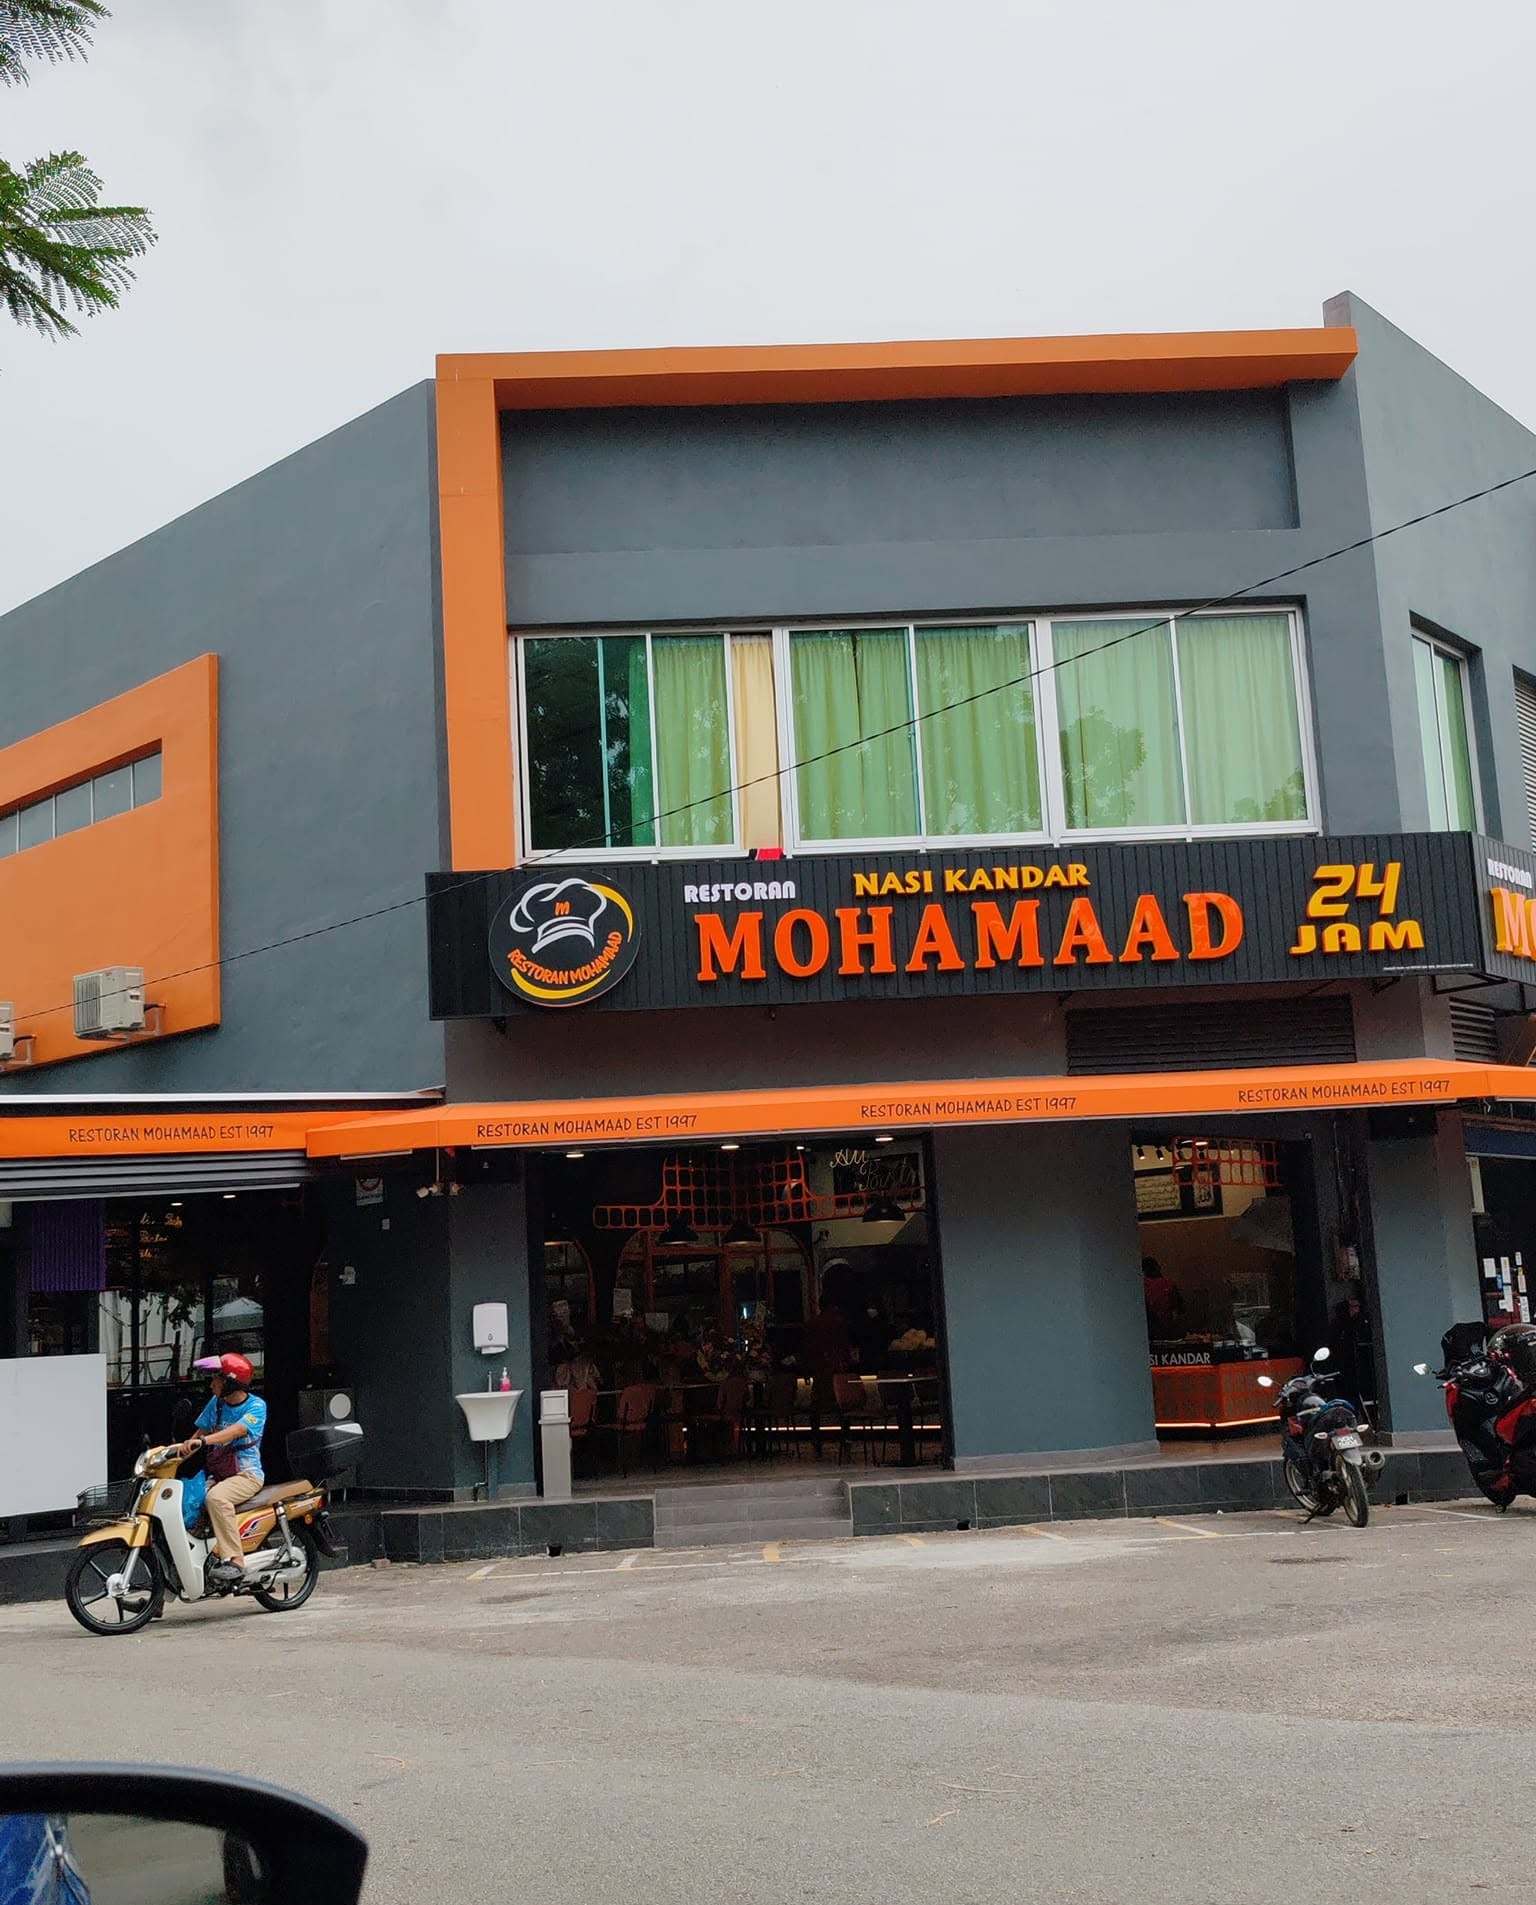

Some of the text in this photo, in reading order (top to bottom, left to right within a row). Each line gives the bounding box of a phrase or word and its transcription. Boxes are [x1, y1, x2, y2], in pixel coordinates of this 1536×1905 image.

[852, 863, 1091, 896] NASI KANDAR
[1307, 862, 1401, 918] 24
[684, 880, 796, 903] RESTORAN
[694, 891, 1244, 982] MOHAMAAD
[1289, 920, 1425, 955] JAM
[507, 931, 623, 985] RESTORAN MOHAMAAD
[1238, 1080, 1450, 1103] RESTORAN MOHAMAAD EST 1997
[861, 1097, 1076, 1118] RESTORAN MOHAMAAD EST 1997
[69, 1125, 274, 1143] RESTORAN MOHAMAAD EST 1997
[477, 1115, 697, 1138] RESTORAN MOHAMAAD EST 1997
[1161, 1352, 1211, 1366] KANDAR
